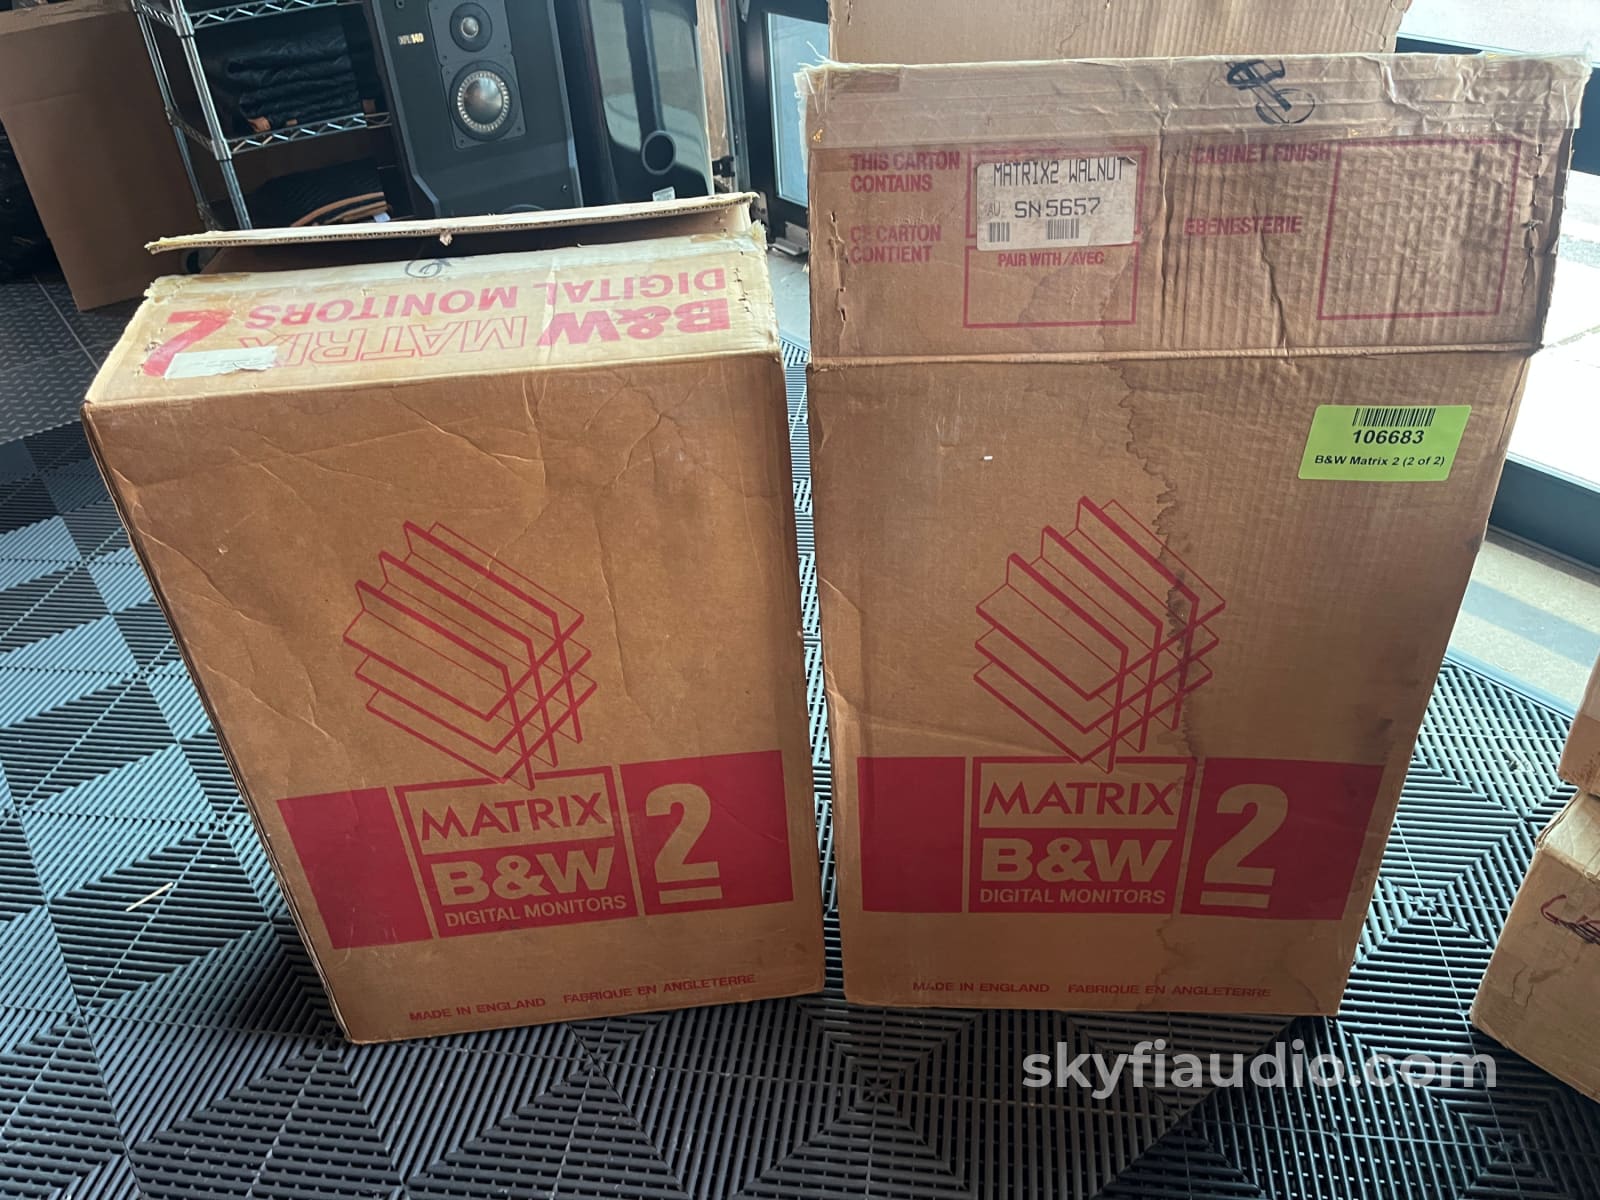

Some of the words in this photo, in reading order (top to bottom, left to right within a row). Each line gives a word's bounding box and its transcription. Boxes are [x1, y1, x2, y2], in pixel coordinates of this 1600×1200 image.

[851, 153, 889, 172] THIS
[892, 151, 960, 171] CARTON
[1191, 142, 1269, 164] CABINET
[1273, 142, 1332, 162] FINISH
[851, 174, 933, 193] CONTAINS
[993, 160, 1059, 187] MATRIX2
[1068, 156, 1126, 183] WALNUT
[851, 225, 873, 243] CE
[876, 223, 941, 243] CARTON
[852, 245, 932, 264] CONTIENT
[998, 251, 1027, 267] PAIR
[533, 267, 727, 305] DIGITAL
[245, 285, 519, 330] MONITORS
[536, 298, 731, 347] B&W
[1352, 429, 1425, 445] 106683
[1315, 455, 1347, 465] B&W
[1350, 456, 1388, 466] Matrix
[1392, 457, 1400, 466] 2
[1402, 456, 1415, 468] (2
[1418, 456, 1431, 466] of
[1434, 456, 1446, 468] 2)
[983, 781, 1178, 816] MATRIX
[421, 792, 609, 842] MATRIX
[645, 783, 720, 884] 2
[1202, 783, 1289, 887] 2
[981, 837, 1173, 883] B&W
[430, 847, 616, 906] B&W
[445, 907, 521, 927] DIGITAL
[525, 895, 626, 920] MONITORS
[979, 888, 1055, 904] DIGITAL
[1059, 888, 1165, 904] MONITORS
[409, 1008, 452, 1022] MADE
[456, 1005, 472, 1016] IN
[476, 998, 546, 1014] ENGLAND
[563, 987, 633, 1004] FABRIQUE
[637, 984, 657, 995] EN
[663, 974, 756, 993] ANGLETERRE
[912, 982, 954, 991] MADE
[959, 982, 974, 992] IN
[979, 983, 1050, 993] ENGLAND
[1068, 984, 1140, 994] FABRIQUE
[1145, 984, 1166, 995] EN
[1171, 985, 1271, 998] ANGLETERRE
